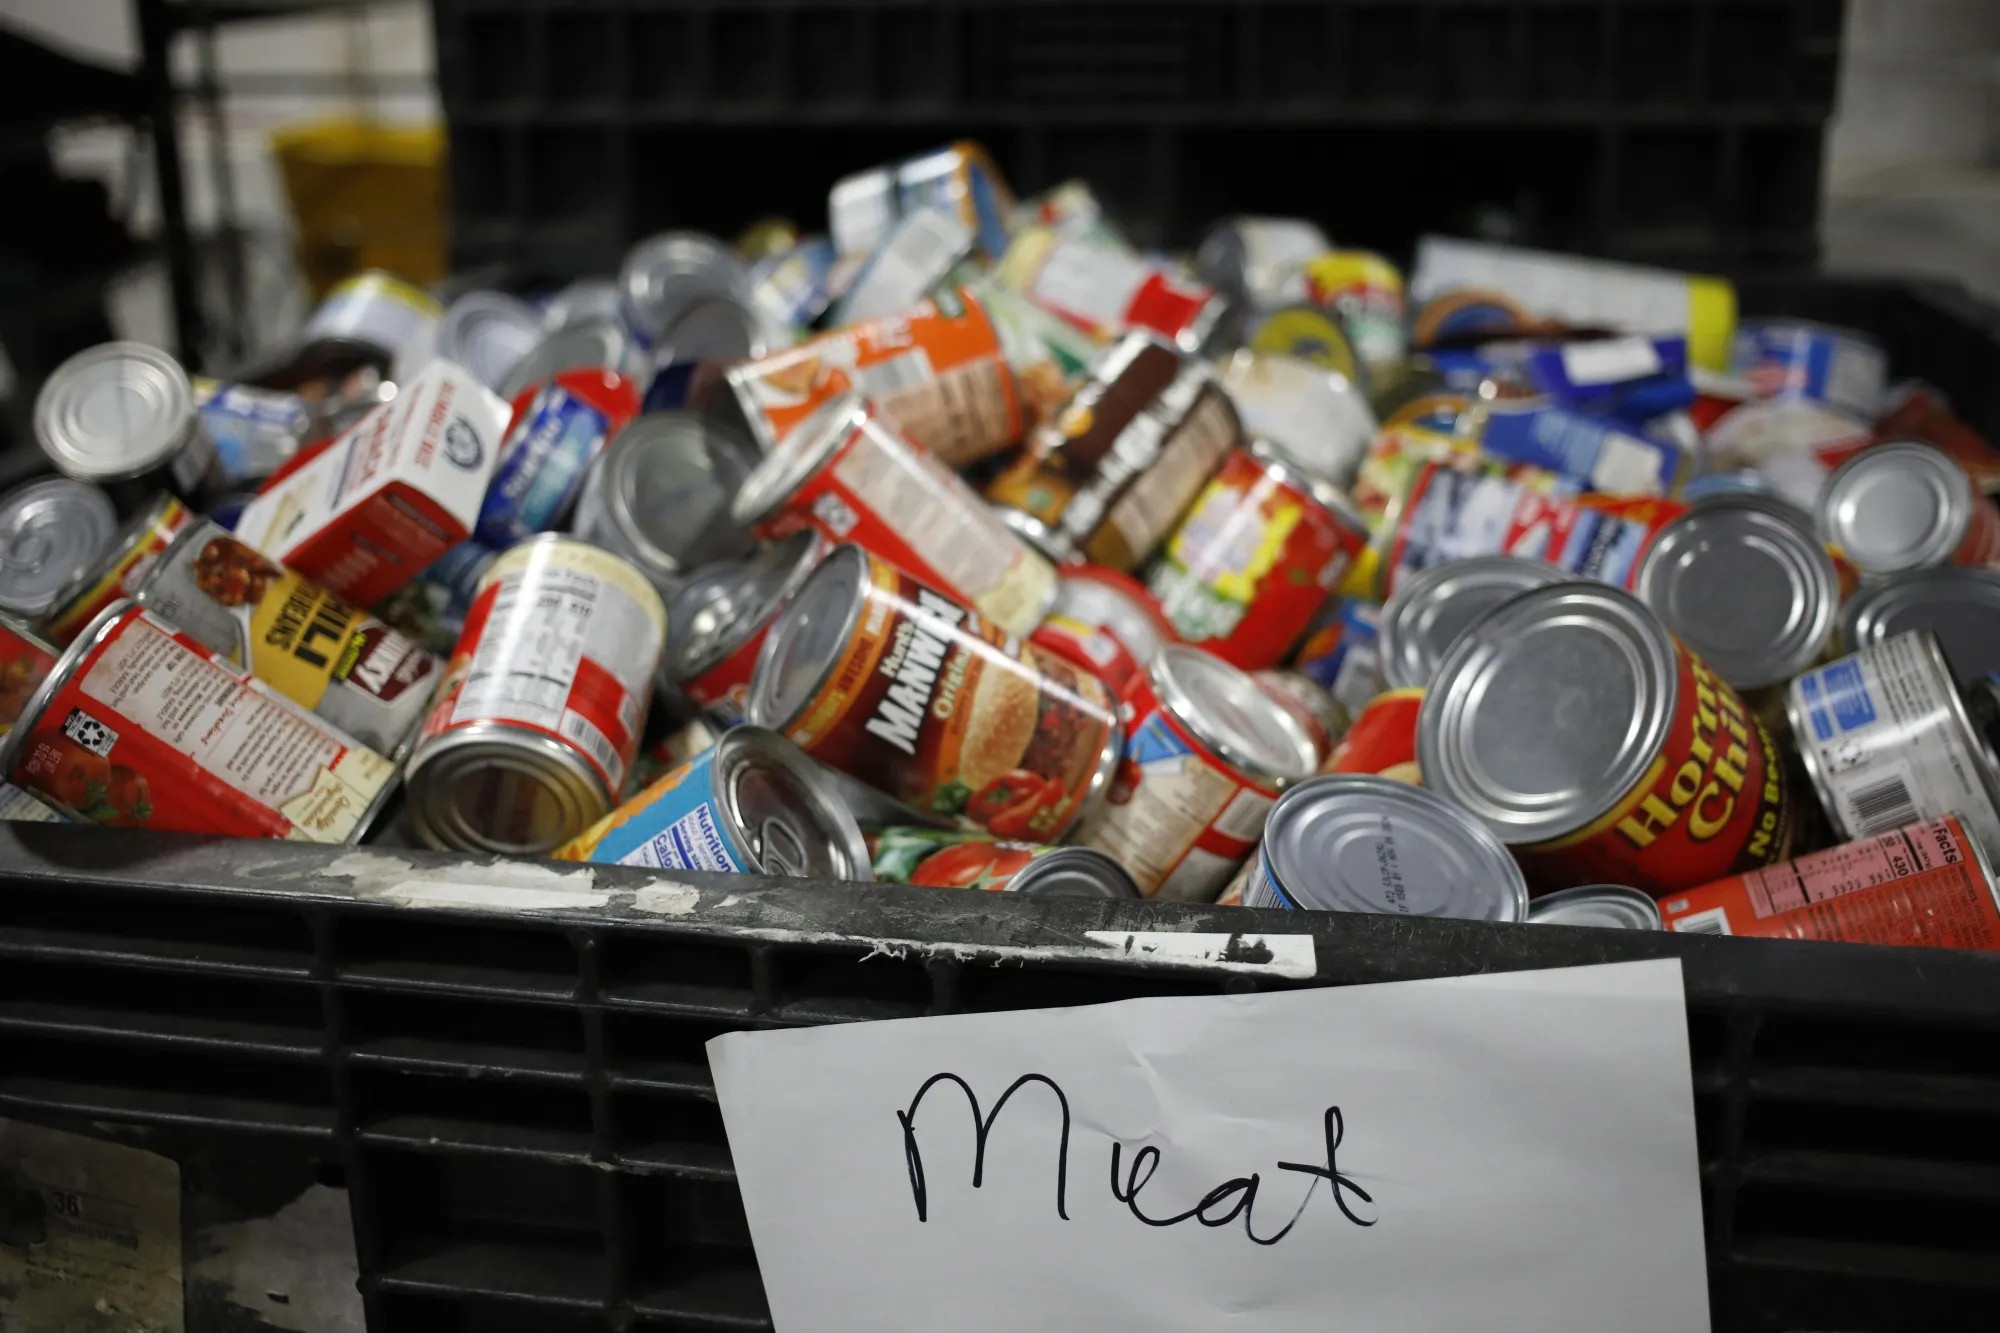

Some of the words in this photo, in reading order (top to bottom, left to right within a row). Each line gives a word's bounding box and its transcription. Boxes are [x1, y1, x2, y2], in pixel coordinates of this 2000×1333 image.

[696, 804, 732, 873] Nutrition
[1748, 811, 1777, 858] No
[1931, 828, 1958, 864] Facts
[1891, 854, 1910, 877] 430
[897, 1071, 1380, 1247] Meat
[52, 1191, 80, 1216] 36
